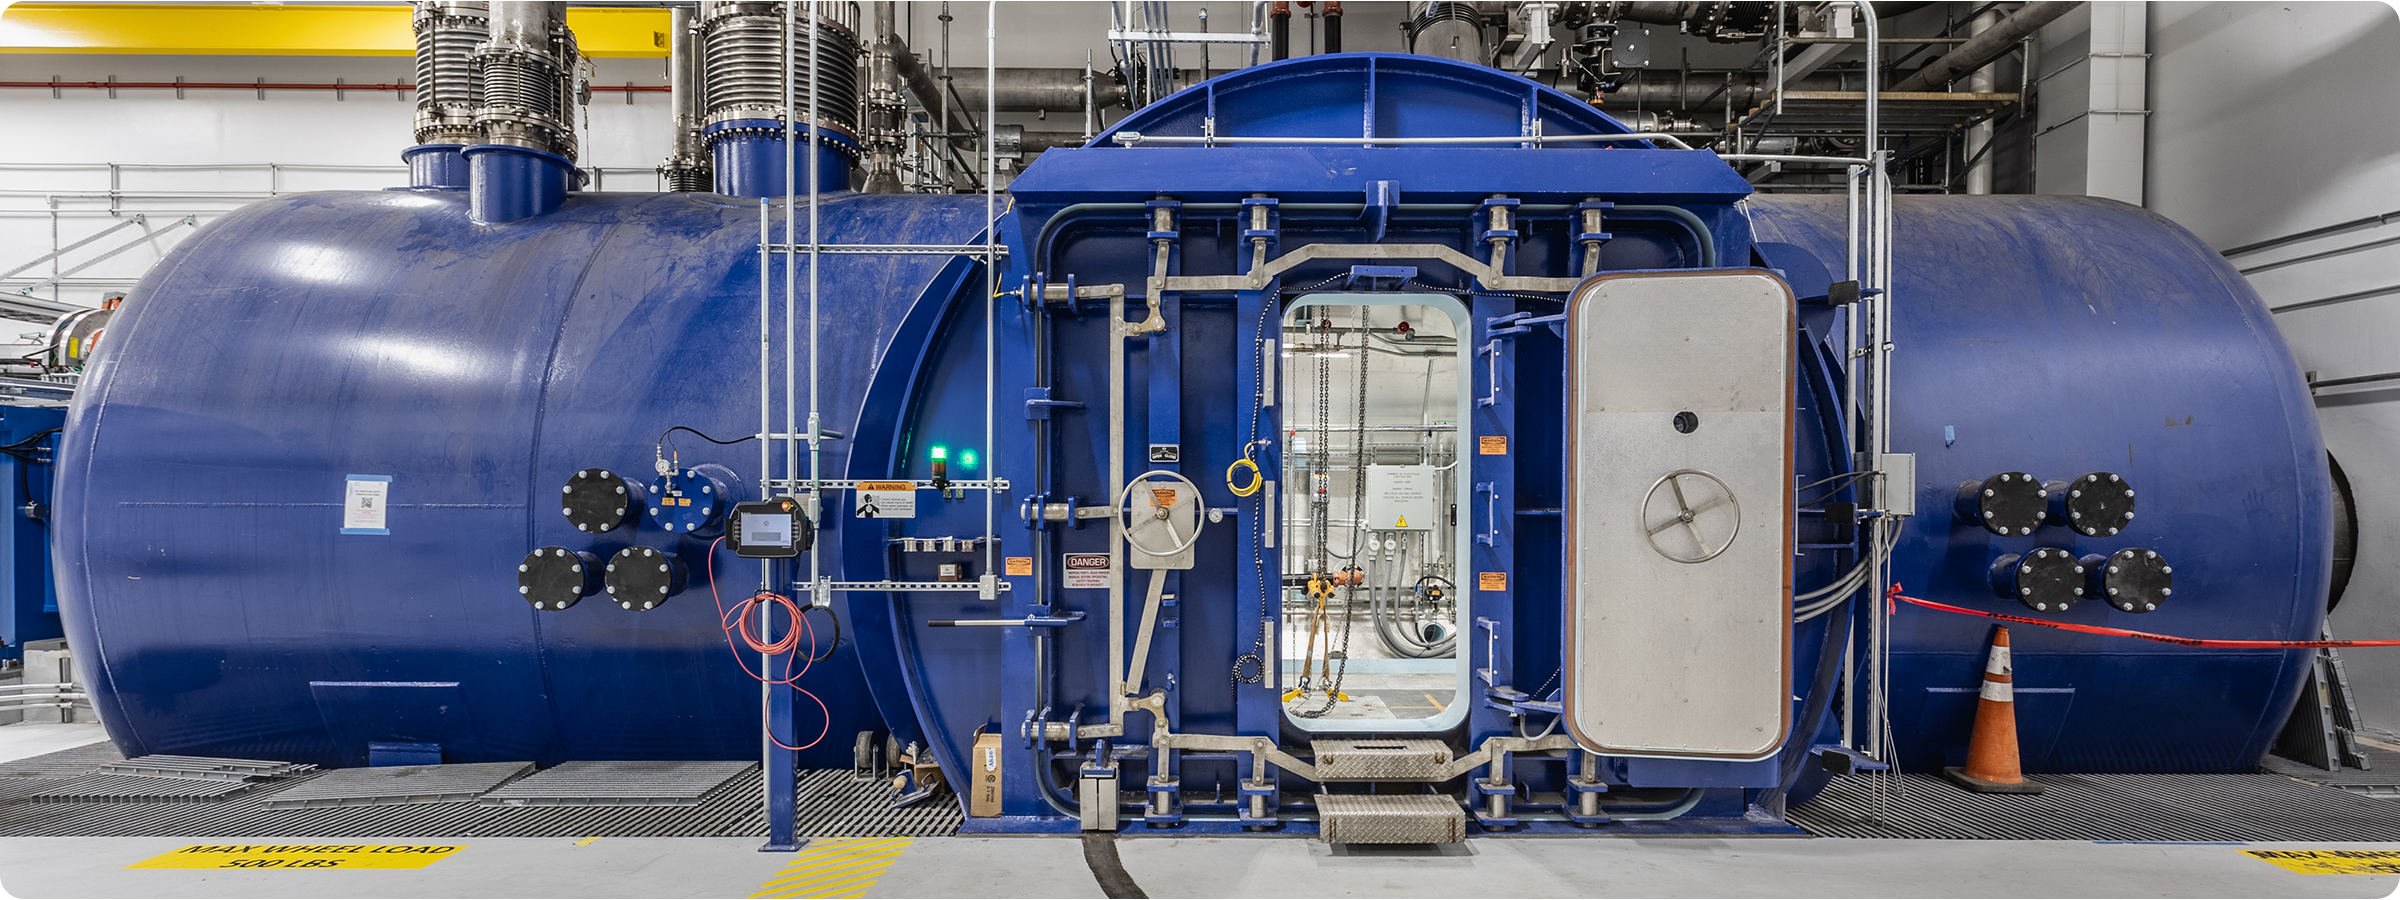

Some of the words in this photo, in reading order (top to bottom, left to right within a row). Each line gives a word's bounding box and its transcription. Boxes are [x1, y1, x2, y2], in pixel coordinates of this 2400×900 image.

[1071, 558, 1106, 566] DANGER
[179, 845, 261, 854] MAX
[262, 845, 365, 854] WHEEL
[370, 845, 456, 854] LOAD
[219, 859, 286, 869] 500
[283, 859, 347, 869] LBS
